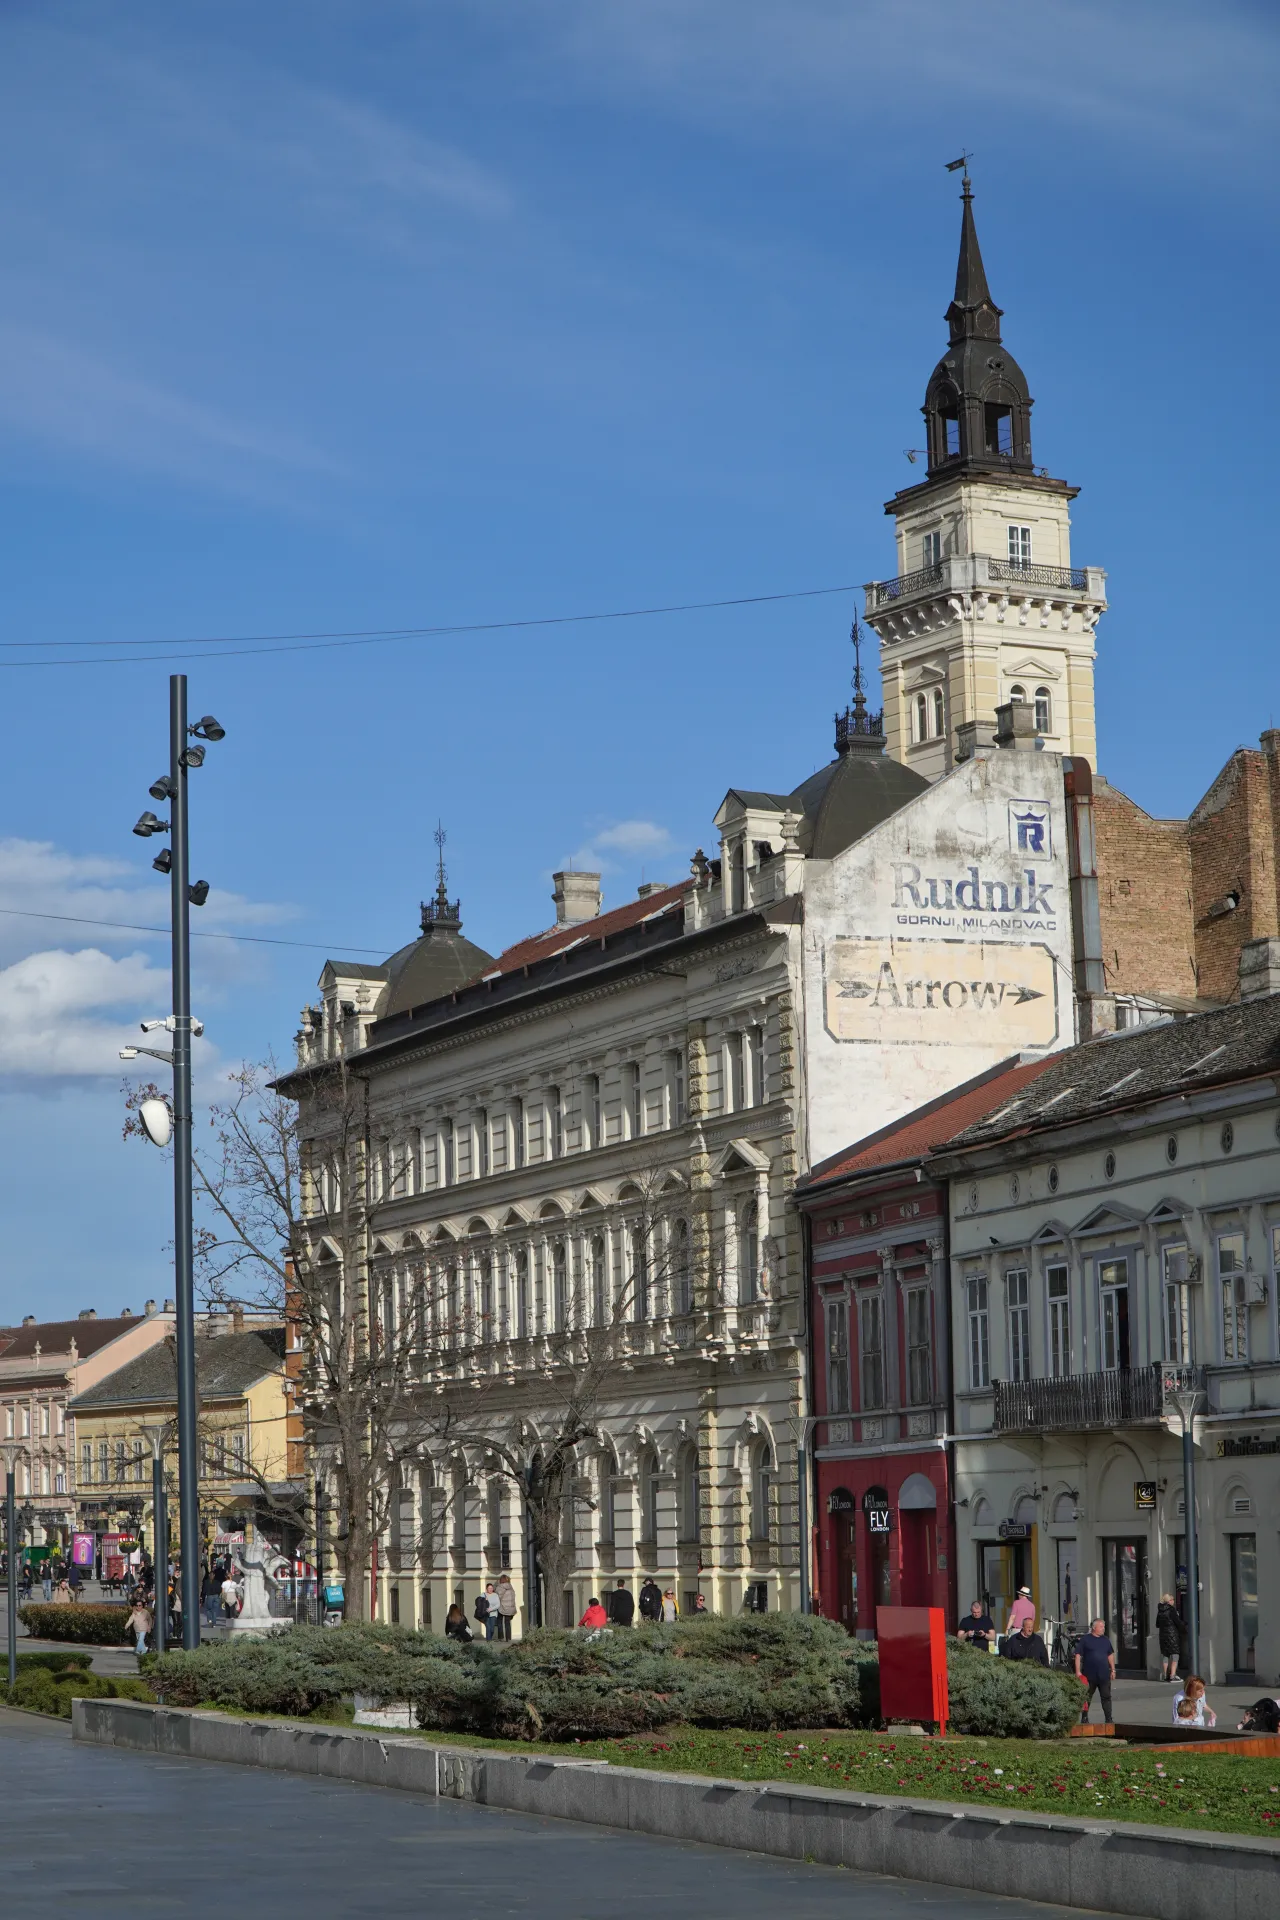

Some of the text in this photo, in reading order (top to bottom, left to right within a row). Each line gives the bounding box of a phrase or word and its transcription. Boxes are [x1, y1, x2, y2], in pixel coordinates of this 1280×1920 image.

[1016, 822, 1045, 853] R
[890, 861, 1056, 915] Rudnik
[897, 915, 1057, 932] GORNJI MILANOVAC
[869, 961, 1008, 1010] Arrow
[870, 1510, 889, 1527] FLY
